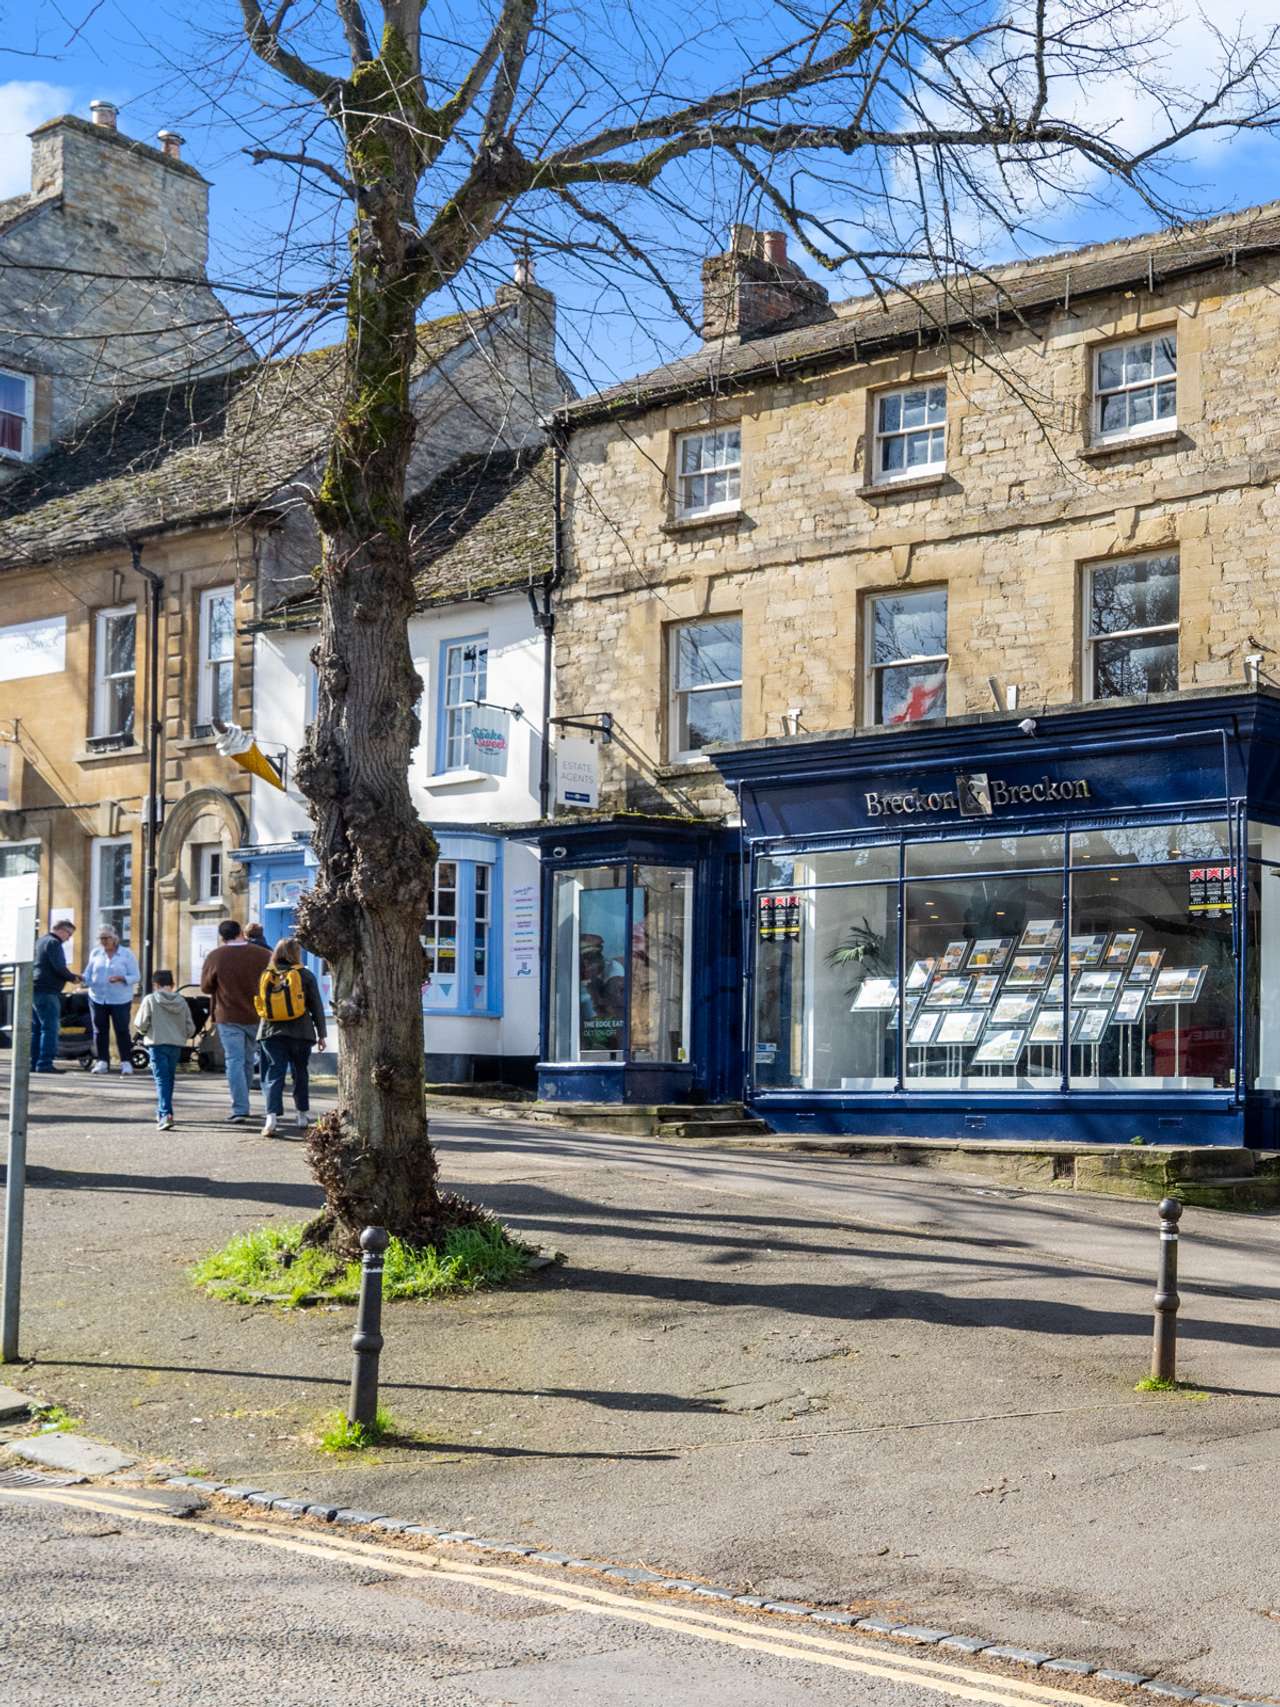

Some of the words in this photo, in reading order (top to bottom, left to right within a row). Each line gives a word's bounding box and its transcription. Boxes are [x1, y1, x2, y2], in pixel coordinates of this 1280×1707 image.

[562, 761, 592, 773] ESTATE
[561, 772, 594, 784] AGENTS
[864, 788, 957, 816] Breckon
[964, 778, 990, 814] &
[991, 776, 1091, 805] Breckon
